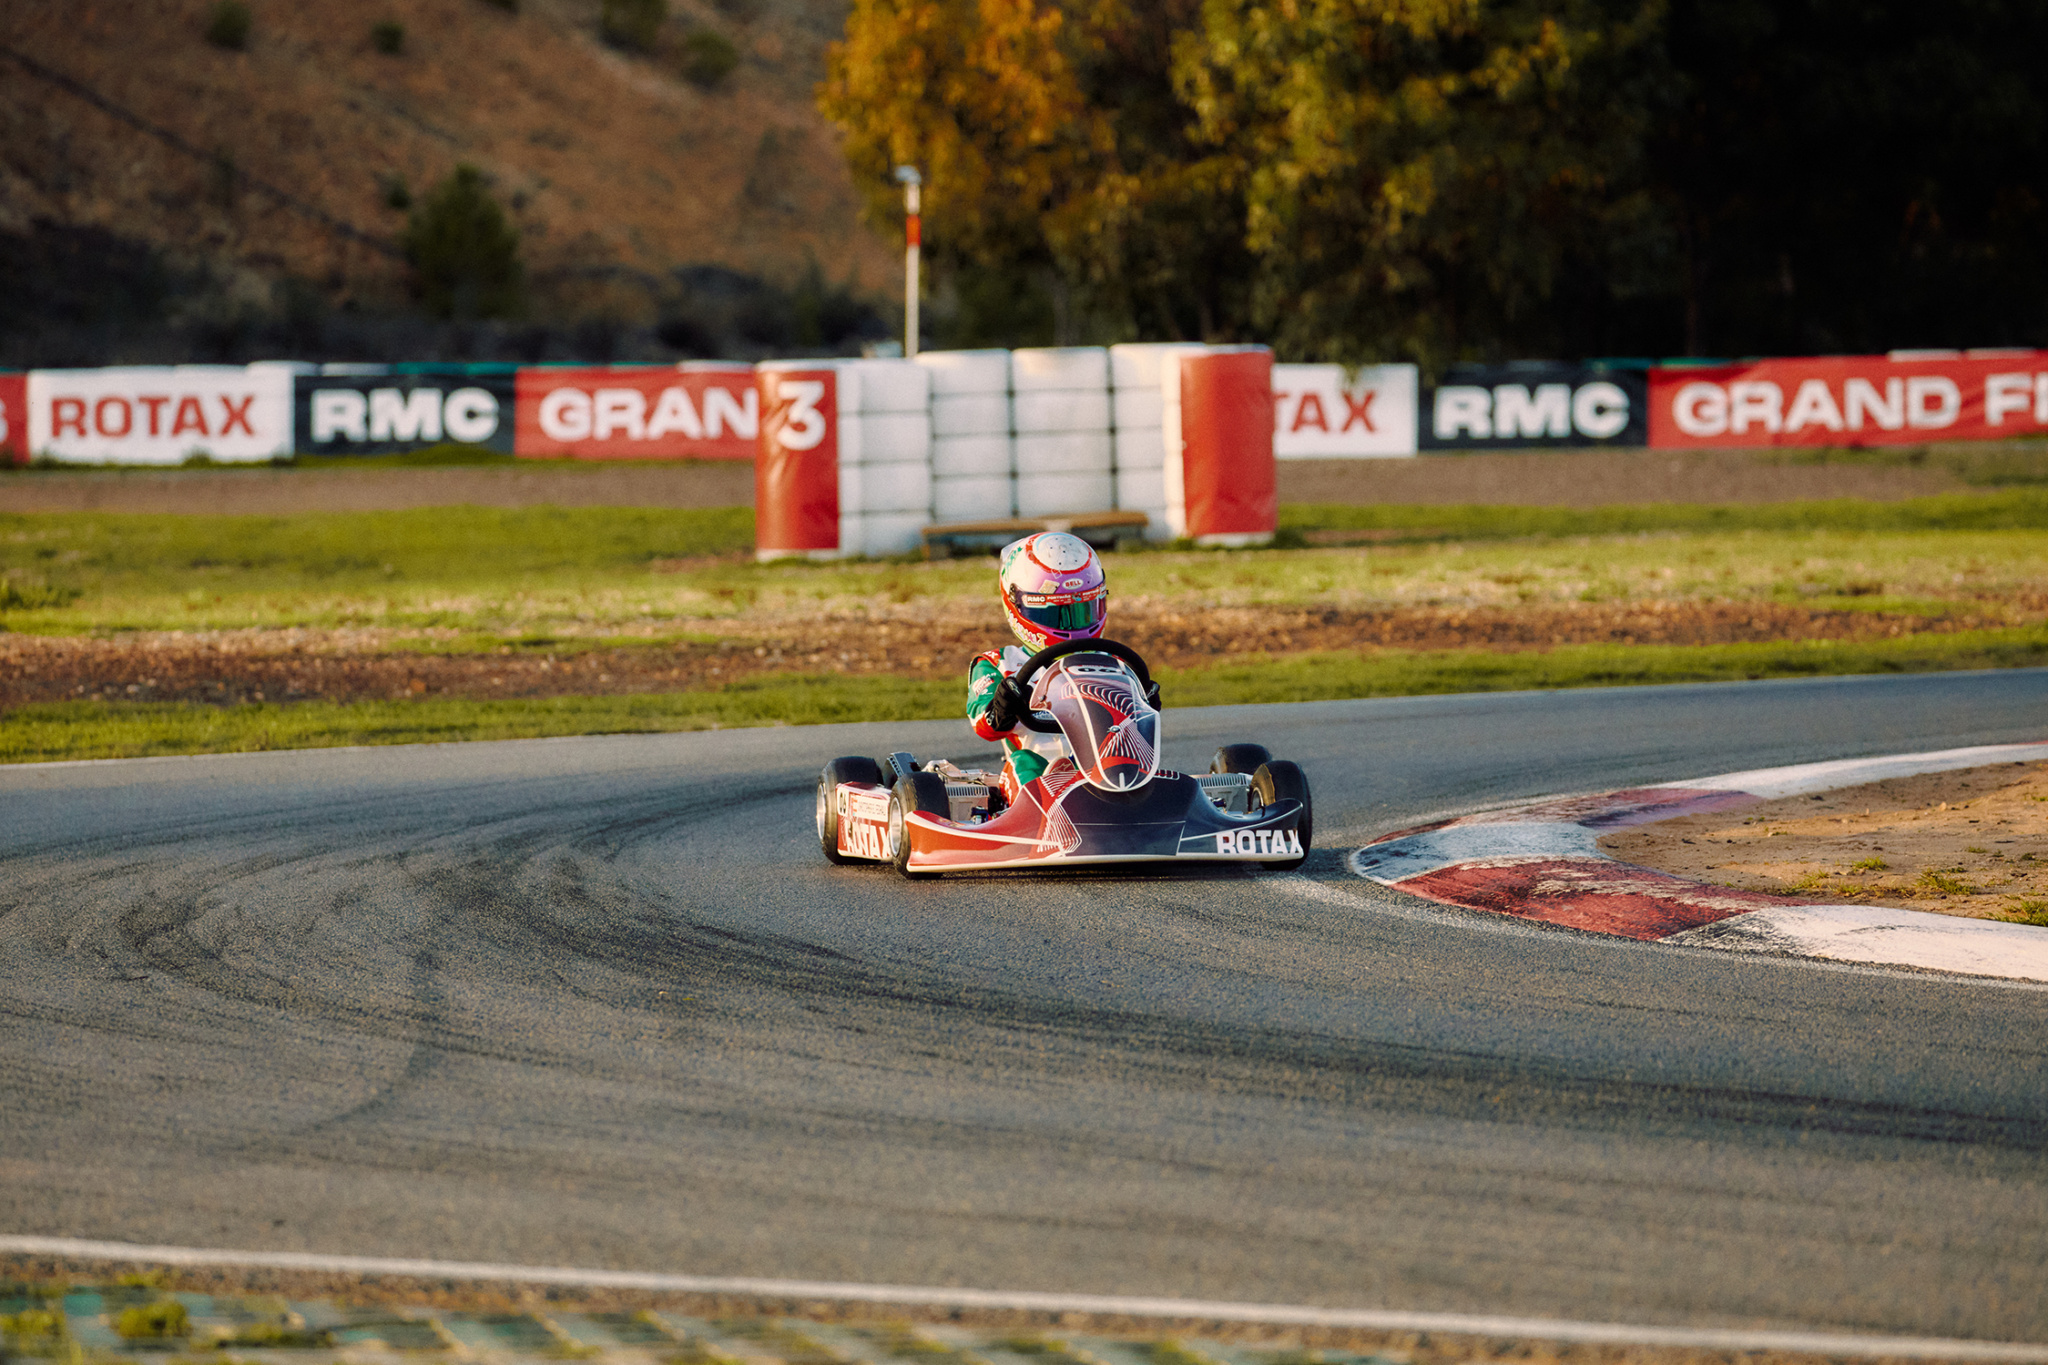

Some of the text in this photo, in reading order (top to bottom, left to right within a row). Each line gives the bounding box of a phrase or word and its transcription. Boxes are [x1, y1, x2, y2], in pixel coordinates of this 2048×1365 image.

[51, 396, 257, 438] ROTAX
[310, 388, 499, 442] RMC
[538, 387, 759, 440] GRAN
[777, 380, 826, 451] 3
[1433, 382, 1630, 439] RMC
[1672, 377, 1962, 436] GRAND
[1027, 595, 1046, 603] RMC
[1216, 829, 1304, 854] ROTAX
